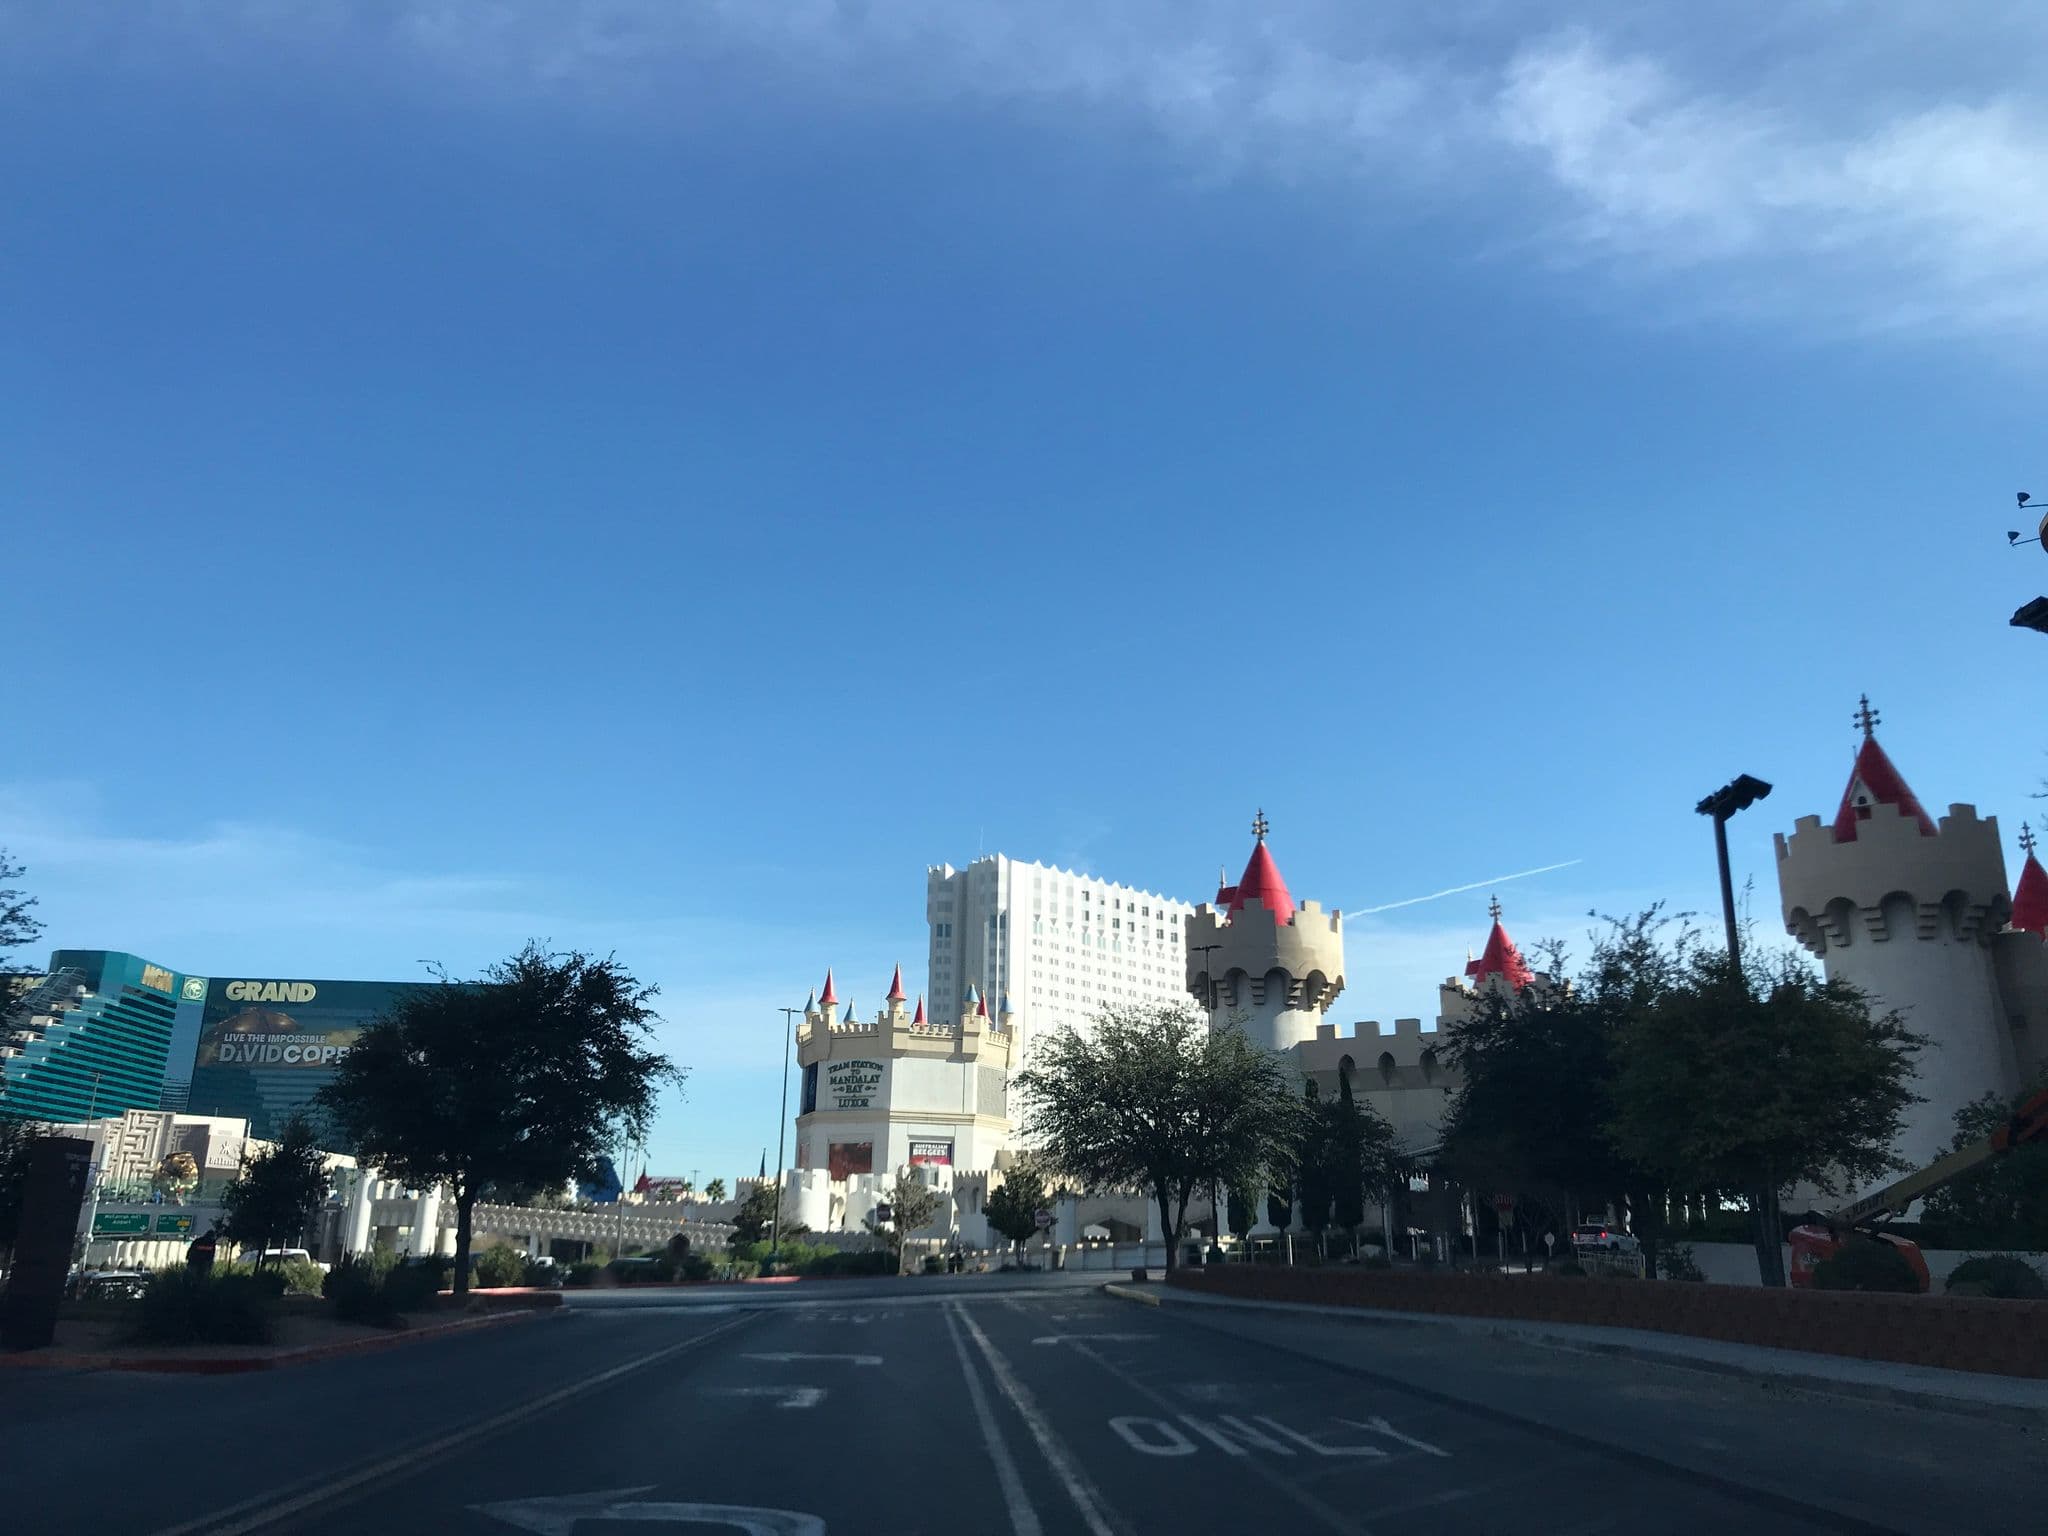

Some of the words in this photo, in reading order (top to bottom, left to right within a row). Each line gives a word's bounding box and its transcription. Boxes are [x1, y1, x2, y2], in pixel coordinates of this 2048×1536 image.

[225, 980, 317, 1003] GRAND
[224, 1033, 245, 1043] LIVE
[247, 1033, 266, 1043] THE
[268, 1034, 327, 1044] IMPOSSIBLE
[828, 1061, 850, 1074] TRAM
[851, 1060, 884, 1073] STATION
[829, 1074, 881, 1085] MANDALAY
[845, 1084, 864, 1094] BAY
[838, 1098, 869, 1108] LUXOR
[1108, 1413, 1453, 1458] ONLY
